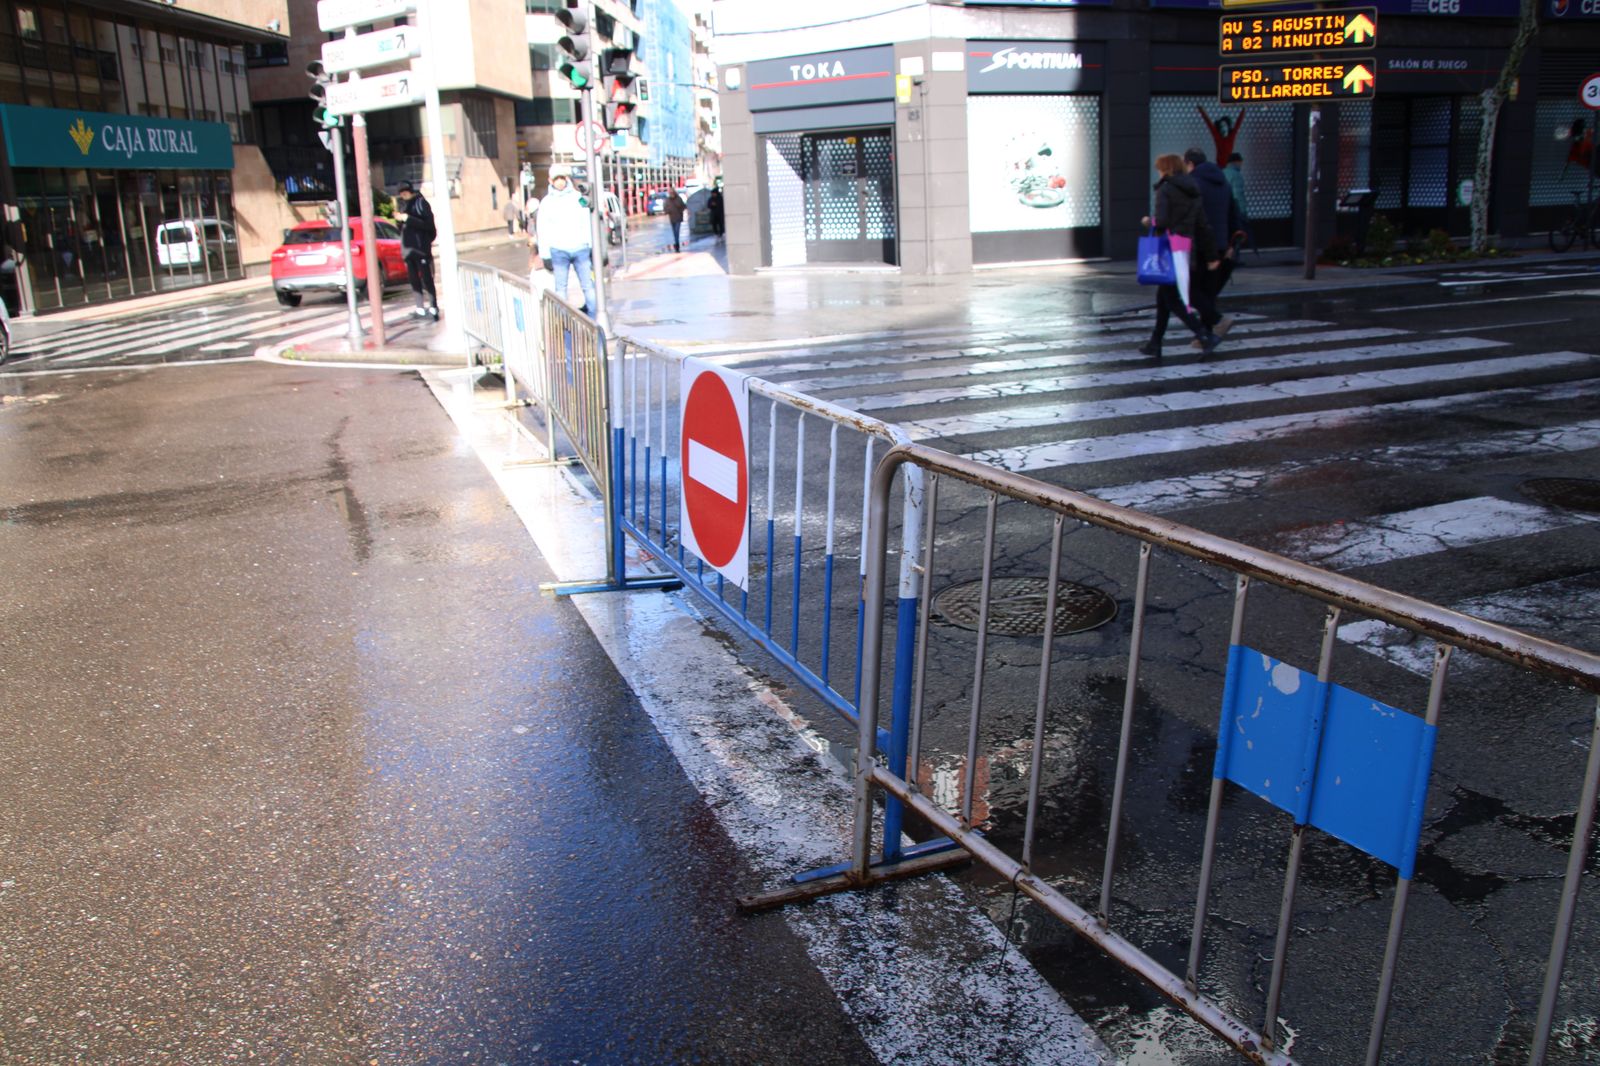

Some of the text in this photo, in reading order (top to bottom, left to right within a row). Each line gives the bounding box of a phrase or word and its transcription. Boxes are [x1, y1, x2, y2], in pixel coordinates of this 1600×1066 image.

[1428, 0, 1460, 13] CEG
[1222, 15, 1345, 34] AV S.AGUSTIN
[1222, 31, 1344, 50] A 02 MINUTOS
[980, 46, 1082, 73] SPORTIUM
[1388, 58, 1468, 69] SALÓN DE JUEGO
[790, 60, 845, 81] TOKA
[1231, 65, 1344, 83] PSO. TORRES
[1231, 82, 1333, 99] VILLARROEL
[102, 124, 197, 159] CAJA RURAL
